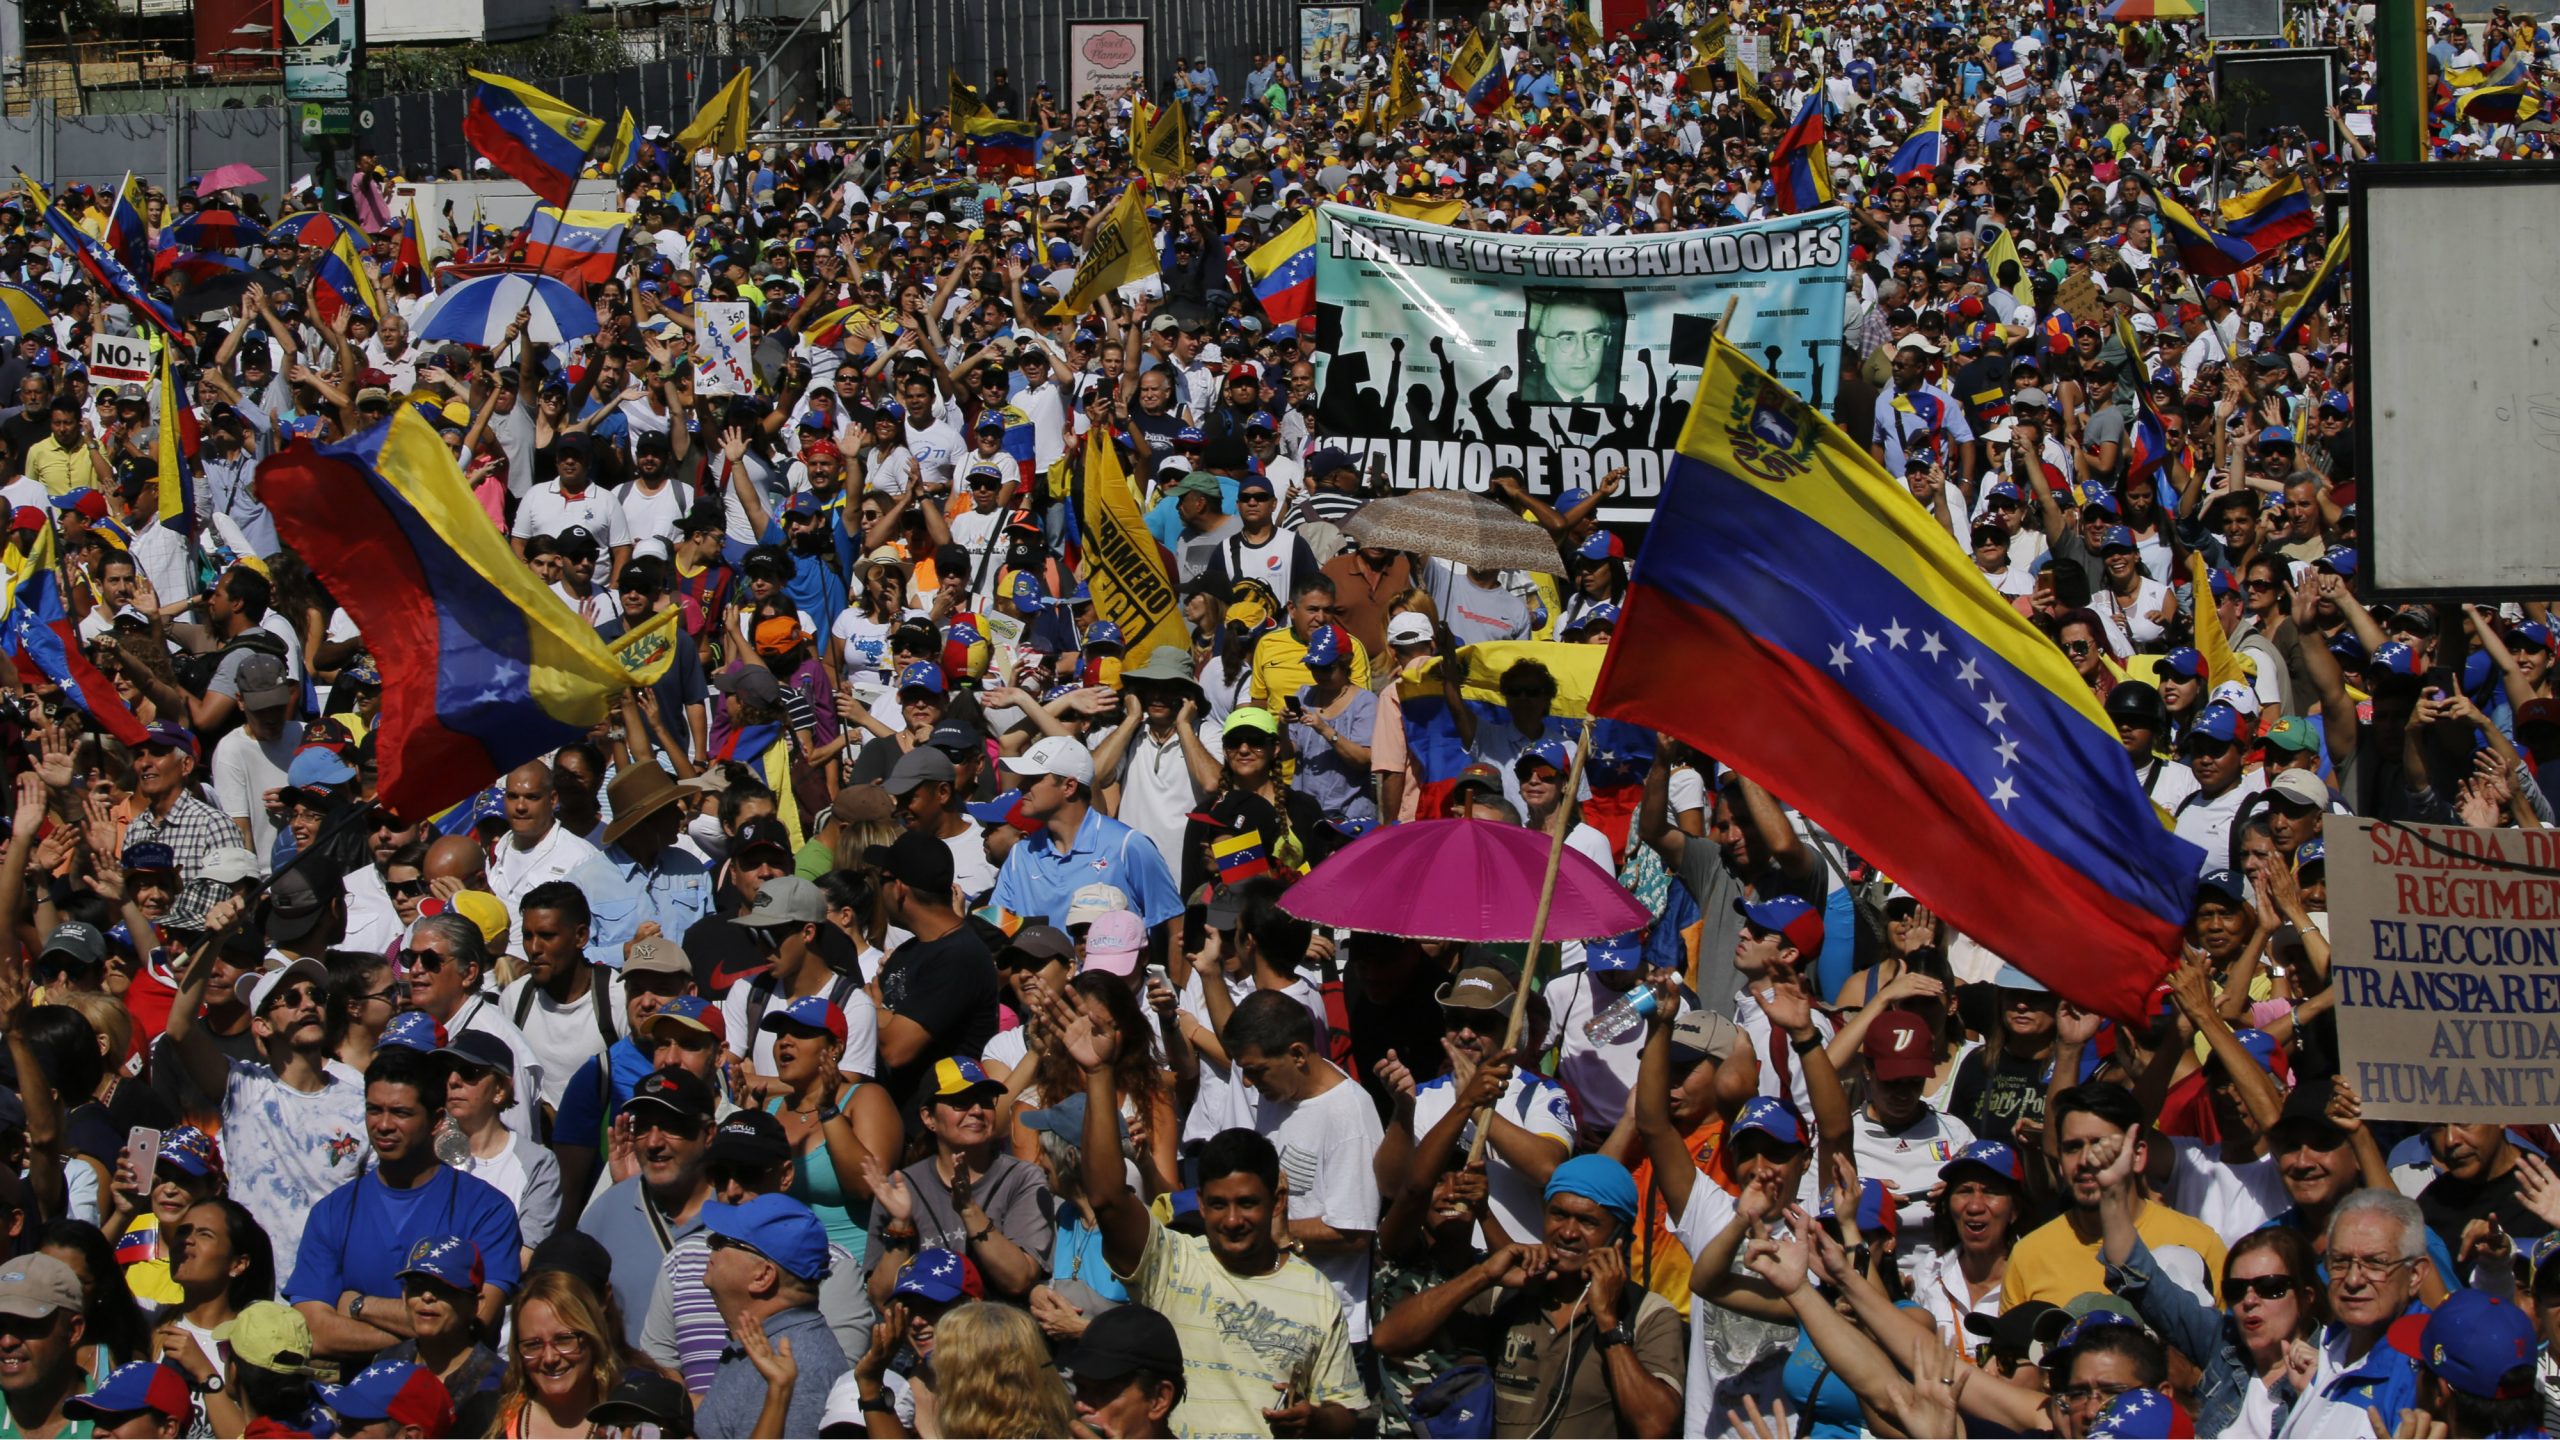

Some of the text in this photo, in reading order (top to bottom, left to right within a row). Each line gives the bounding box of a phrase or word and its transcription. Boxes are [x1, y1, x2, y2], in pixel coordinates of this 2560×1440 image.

[1092, 49, 1129, 60] Planner
[323, 107, 350, 116] ORINOCO
[1330, 216, 1843, 278] FRENTE DE TRABAJADORES
[2369, 822, 2513, 872] SALIDA
[2395, 870, 2560, 921] RÉGIME
[2357, 1061, 2560, 1107] HUMANIT
